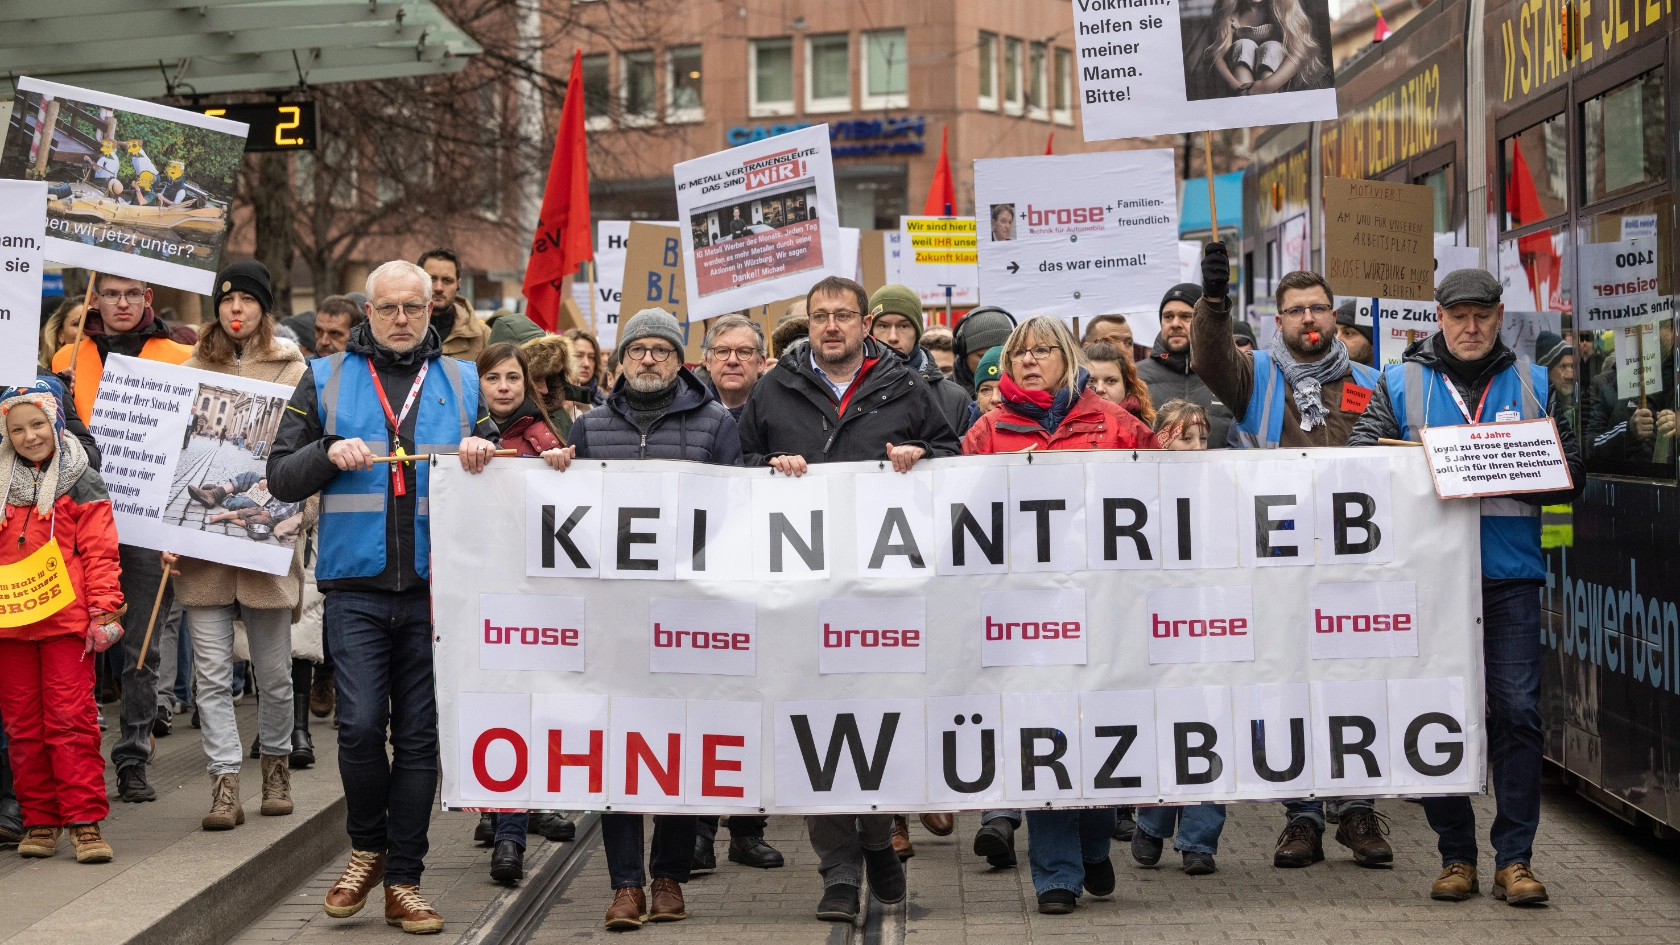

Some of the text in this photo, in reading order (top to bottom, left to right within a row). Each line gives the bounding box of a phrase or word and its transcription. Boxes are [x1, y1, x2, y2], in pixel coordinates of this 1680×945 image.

[1079, 15, 1163, 35] helfen sie
[1081, 41, 1140, 58] meiner
[1083, 65, 1143, 81] Mama.
[1086, 86, 1131, 104] Bitte!
[274, 106, 303, 145] 2.
[1369, 92, 1395, 176] DEIN
[1401, 64, 1439, 161] DING?
[678, 183, 686, 191] IG
[689, 174, 722, 189] METALL
[725, 148, 818, 177] VERTRAUENSLEUTE.
[702, 183, 720, 194] DAS
[724, 176, 745, 189] SIND
[1350, 184, 1403, 199] MOTIVIERT
[1028, 198, 1164, 226] brose Familien-
[1118, 215, 1170, 227] freundlich
[907, 222, 924, 231] Wir
[926, 222, 947, 231] sind
[949, 223, 965, 231] hier
[1337, 212, 1423, 233] AM UND FÜR UNSEREN
[0, 236, 41, 250] ann,
[73, 223, 98, 238] wir
[100, 228, 137, 247] jetzt
[141, 238, 194, 258] unter?
[724, 240, 745, 252] Werber
[747, 238, 757, 246] des
[785, 226, 804, 237] Jeden
[806, 223, 817, 233] Tag
[912, 238, 932, 246] weil
[934, 238, 952, 246] IHR
[1353, 232, 1418, 254] ARBEITSPLATZ
[735, 251, 750, 260] mehr
[776, 239, 794, 250] durch
[796, 235, 812, 244] seine
[776, 250, 787, 260] Wir
[789, 246, 807, 258] sagen
[5, 257, 30, 272] sie
[916, 253, 953, 261] Zukunft
[1039, 254, 1147, 272] das war einmal!
[732, 265, 785, 284] Danke!! Michael
[1331, 258, 1429, 282] BROSE WÜRZBURG MUSS
[1360, 306, 1438, 323] one Zuku
[124, 375, 140, 388] denn
[140, 377, 163, 392] keinen
[172, 384, 194, 397] seiner
[121, 392, 133, 405] der
[104, 408, 127, 422] seinem
[1485, 431, 1511, 439] Jahre
[1434, 444, 1458, 454] loyal
[1474, 442, 1501, 450] Brose
[1503, 438, 1556, 450] gestanden.
[1453, 453, 1481, 462] Jahre
[1501, 450, 1517, 458] der
[1519, 448, 1550, 458] Rente,
[1436, 458, 1562, 474] soll ich für Ihren Reichtum
[1462, 471, 1541, 483] stempeln gehen!
[541, 491, 1382, 573] KEIN ANTRIEB
[11, 577, 36, 590] Halt
[13, 590, 29, 598] ist
[31, 572, 58, 592] unser
[0, 584, 62, 614] BROSE
[1562, 544, 1680, 695] bewerben
[484, 608, 1412, 651] brose brose brose brose brose brose
[472, 711, 1464, 798] OHNE WÜRZBURG
